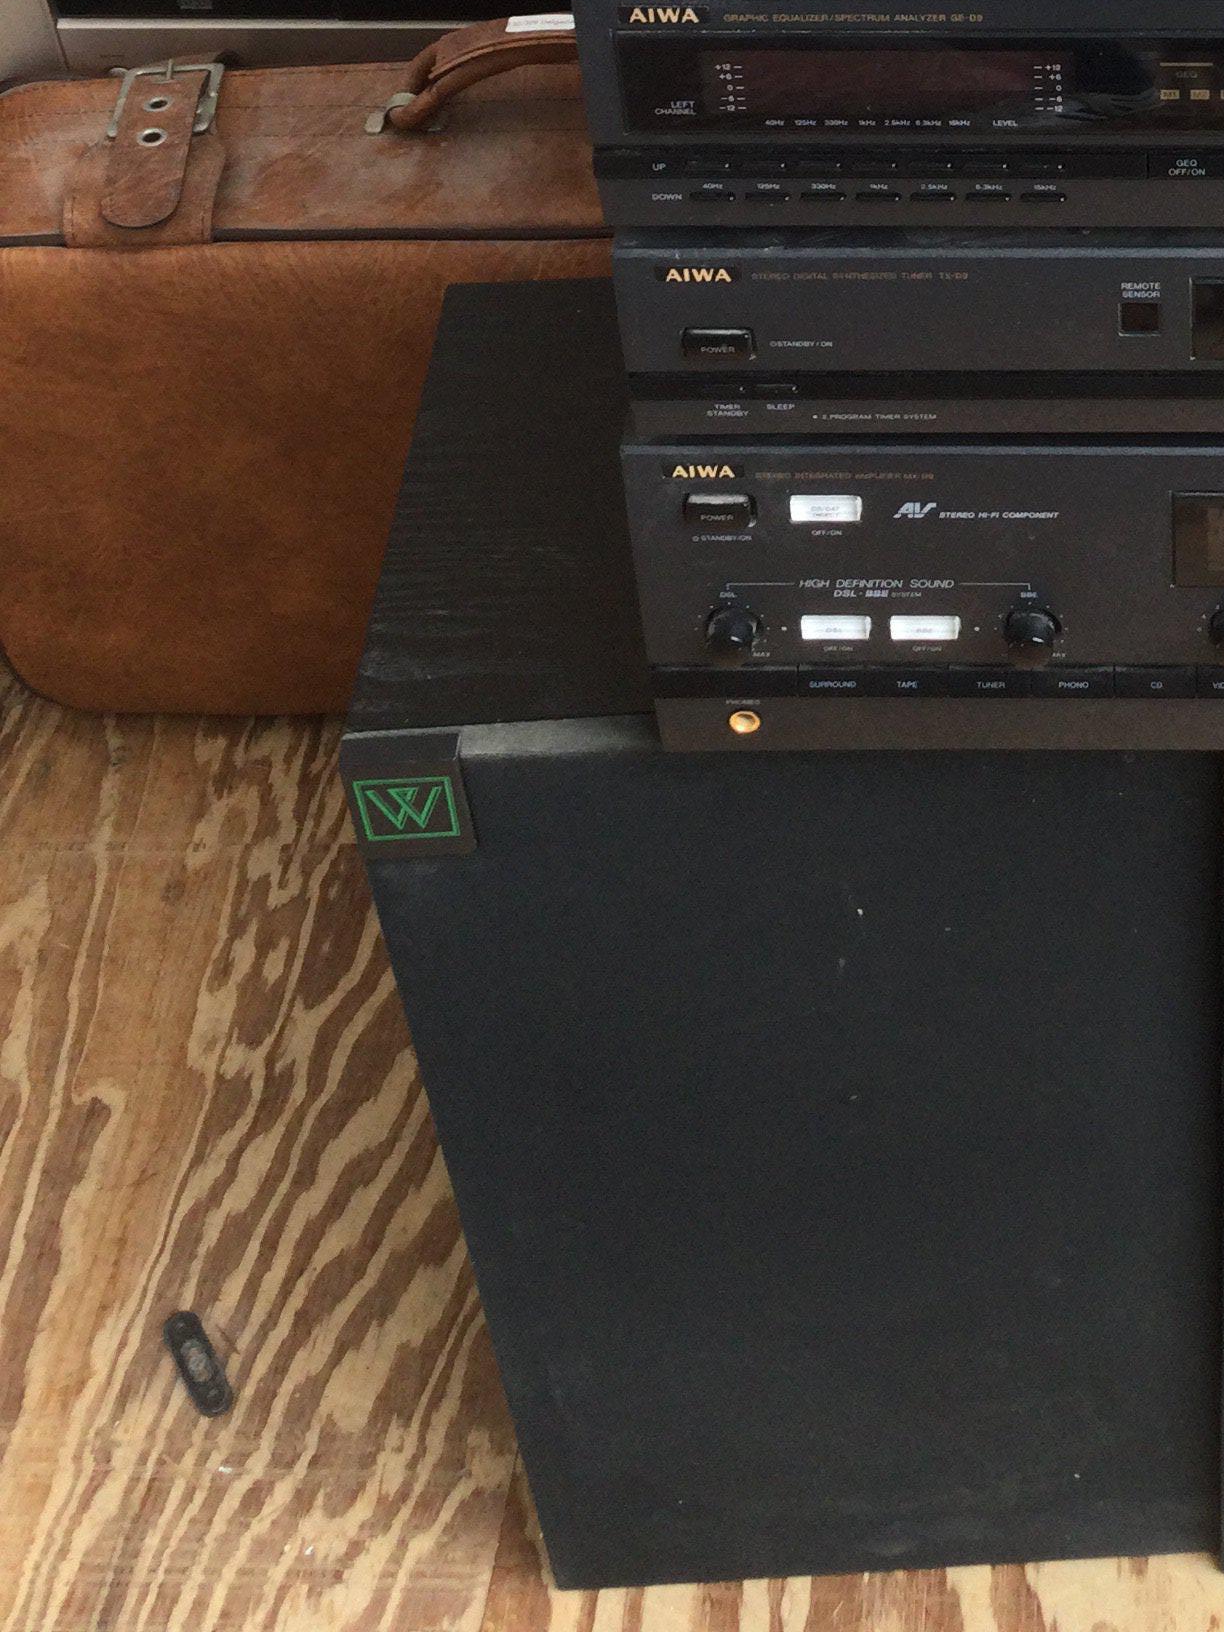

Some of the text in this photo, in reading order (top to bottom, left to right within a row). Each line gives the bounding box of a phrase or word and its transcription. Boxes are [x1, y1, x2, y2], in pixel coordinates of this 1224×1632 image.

[629, 7, 700, 25] AIWA
[665, 267, 732, 283] AIWA
[672, 465, 736, 479] AIWA
[938, 511, 975, 519] STEREO
[1001, 511, 1060, 519] COMPONENT
[798, 578, 955, 589] HIGH DEFINITION SOUND
[976, 681, 1090, 689] TUNER PHONO
